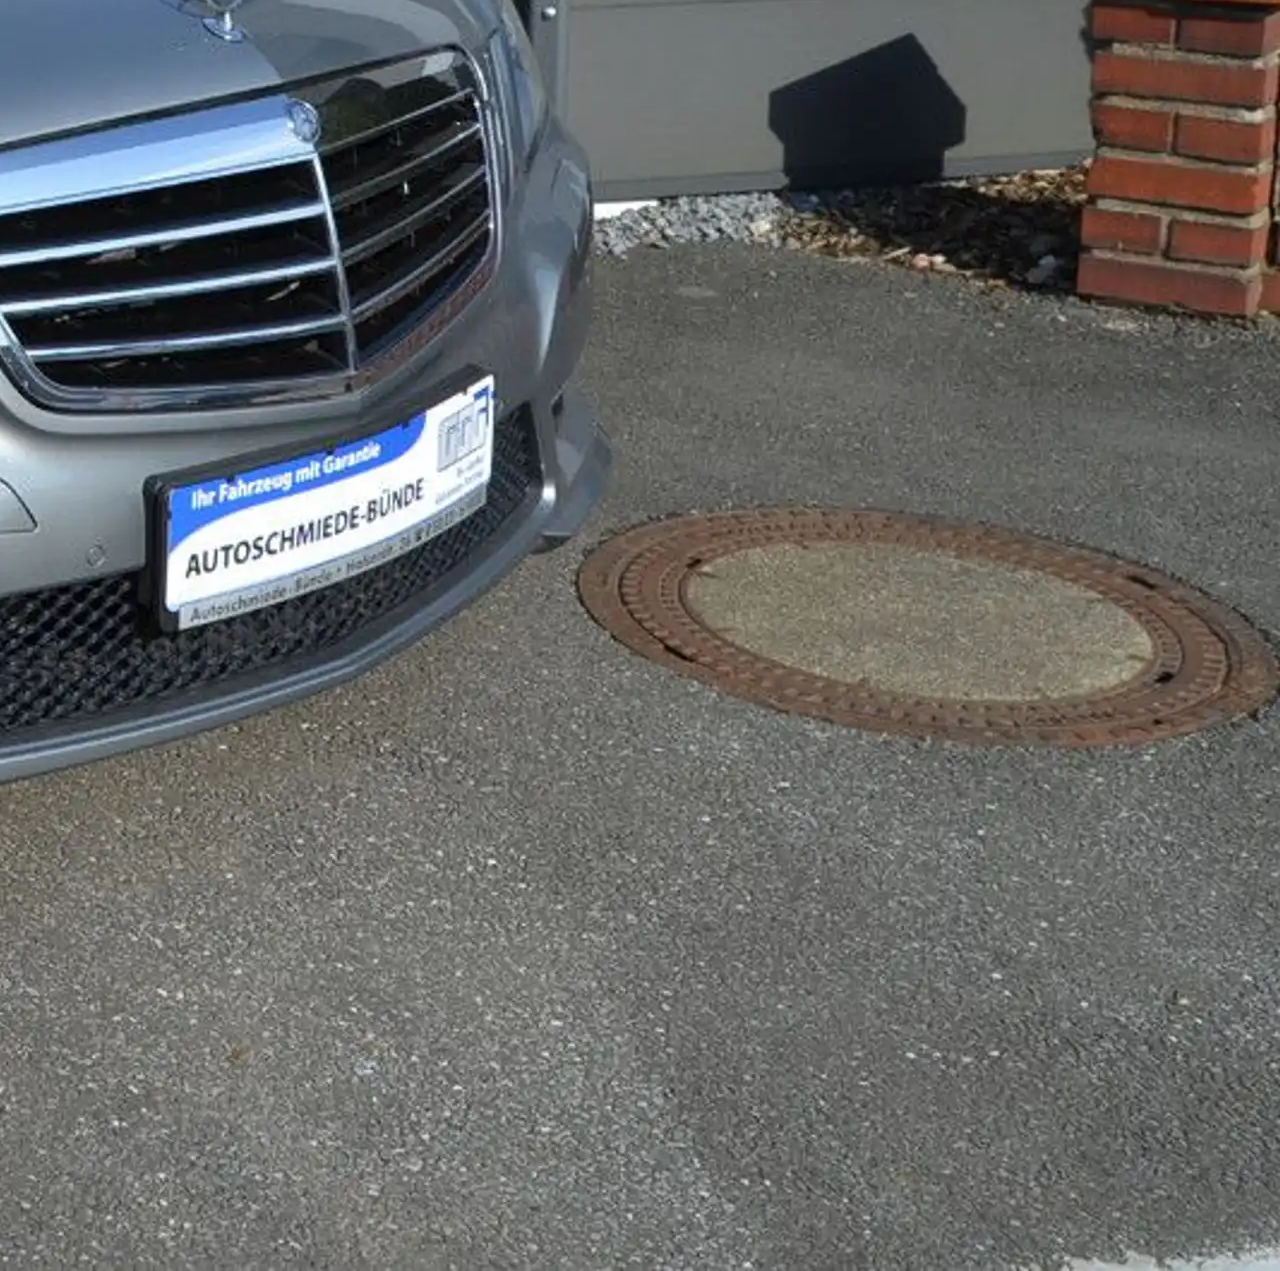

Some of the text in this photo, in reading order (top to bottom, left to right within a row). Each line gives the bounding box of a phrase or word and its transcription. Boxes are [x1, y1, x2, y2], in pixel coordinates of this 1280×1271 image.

[192, 441, 382, 510] Ihr Fahrzeug mit Garantie
[185, 478, 425, 578] AUTOSCHMIEDE-BÜNDE
